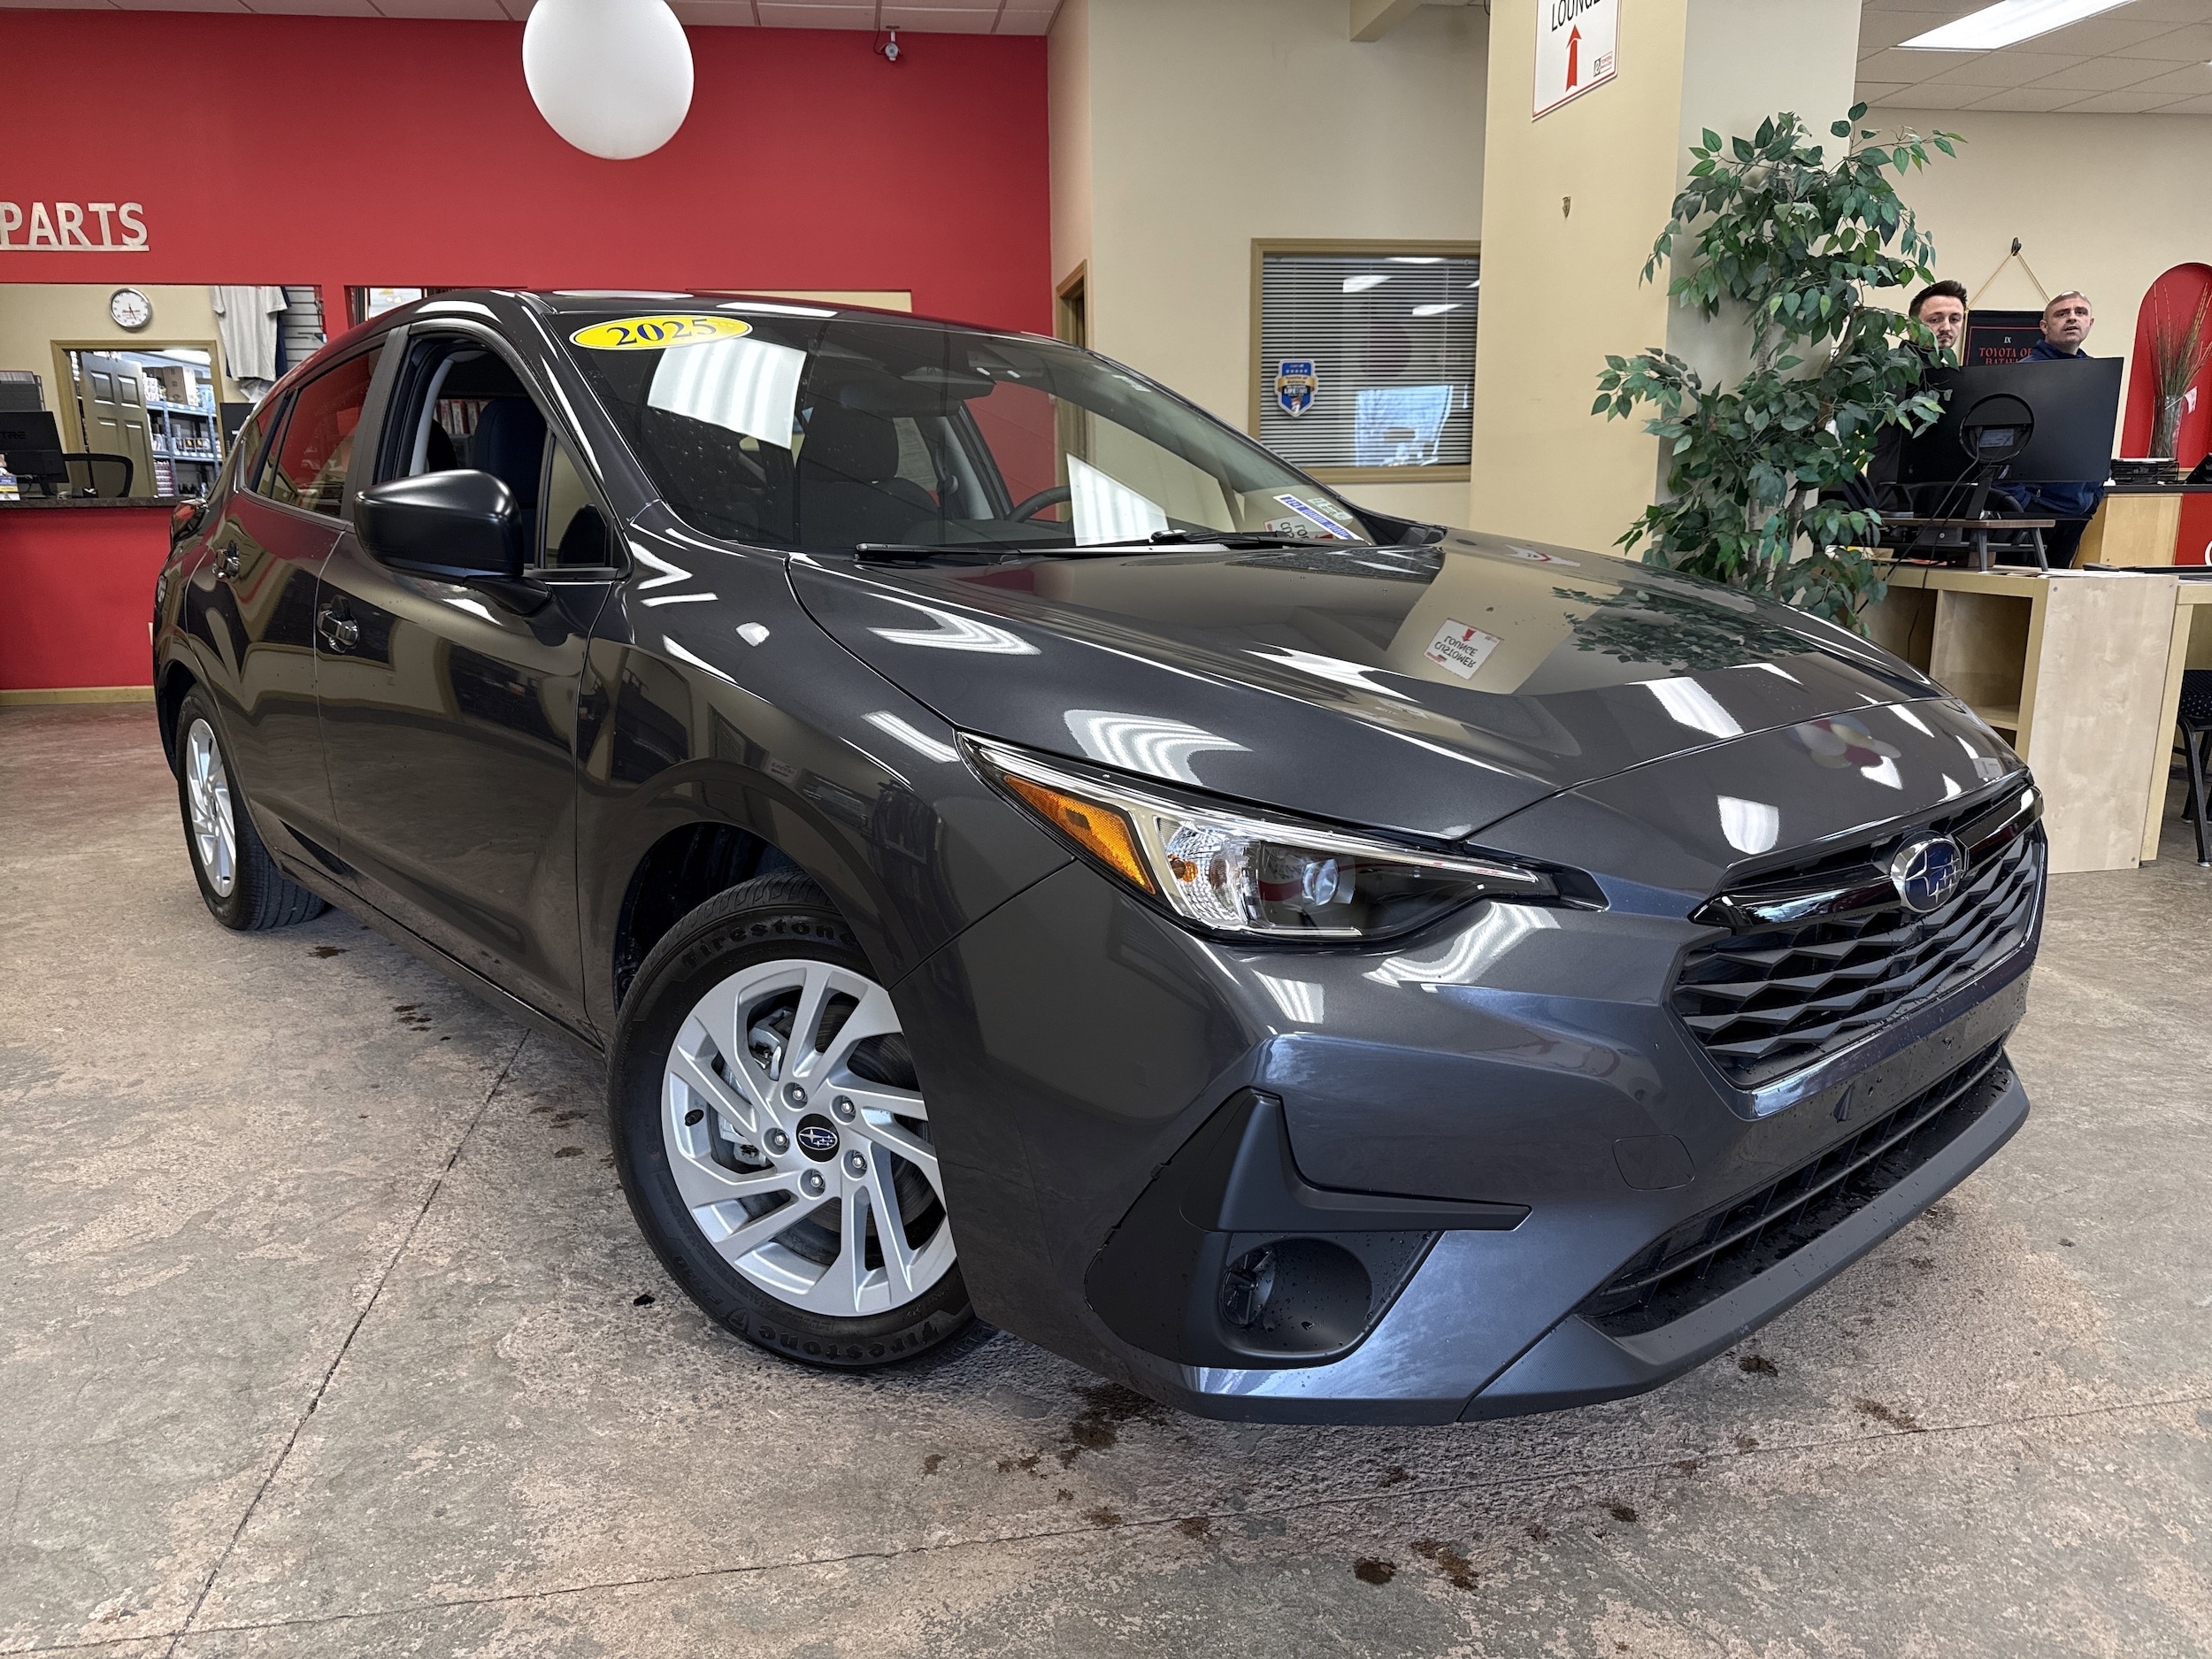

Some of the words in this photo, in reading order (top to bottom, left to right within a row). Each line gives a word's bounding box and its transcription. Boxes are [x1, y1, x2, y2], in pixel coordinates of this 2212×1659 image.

[1552, 0, 1600, 32] LOUN
[0, 202, 148, 247] PARTS
[607, 319, 717, 346] 2025
[1978, 347, 2016, 357] TOYOTA
[681, 918, 857, 969] Firestone
[757, 1320, 940, 1361] Firestone
